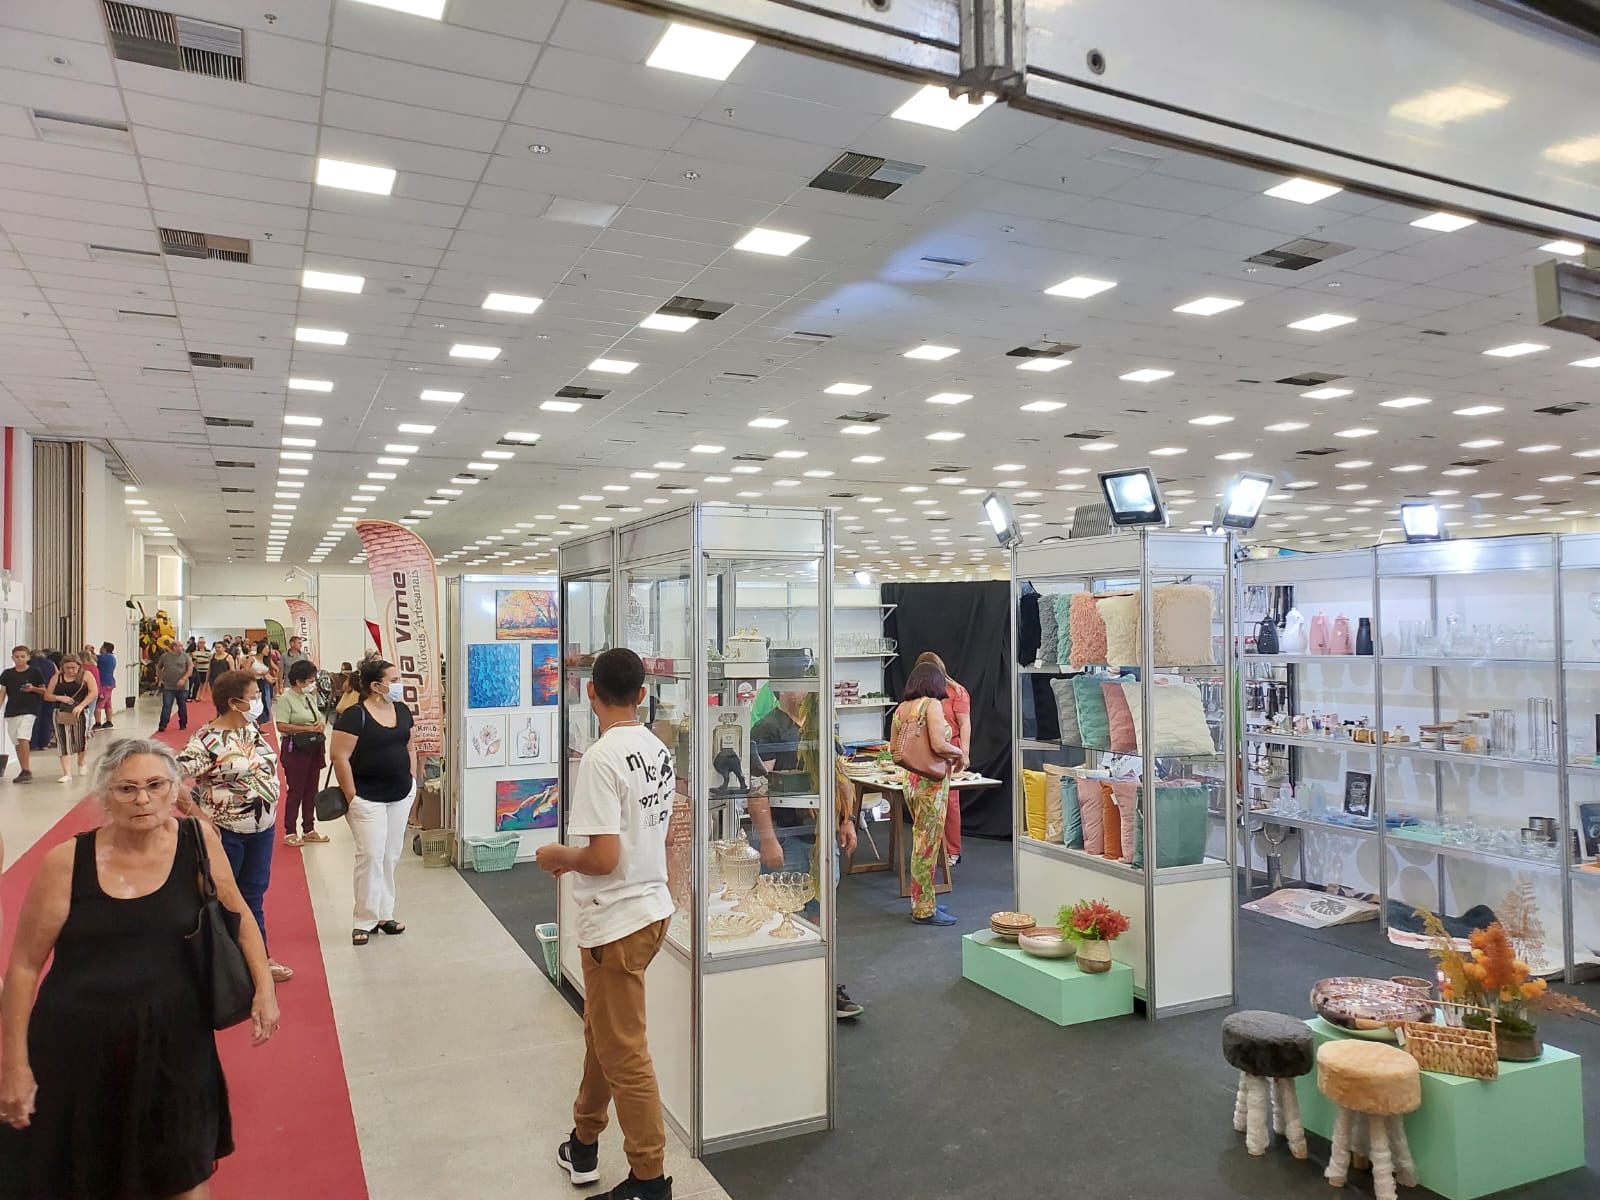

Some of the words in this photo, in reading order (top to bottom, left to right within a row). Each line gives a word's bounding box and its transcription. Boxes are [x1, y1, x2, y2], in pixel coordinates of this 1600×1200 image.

[392, 571, 412, 643] Vime
[409, 569, 425, 629] Artesanais
[416, 633, 430, 673] Móveis
[638, 792, 660, 811] 1972
